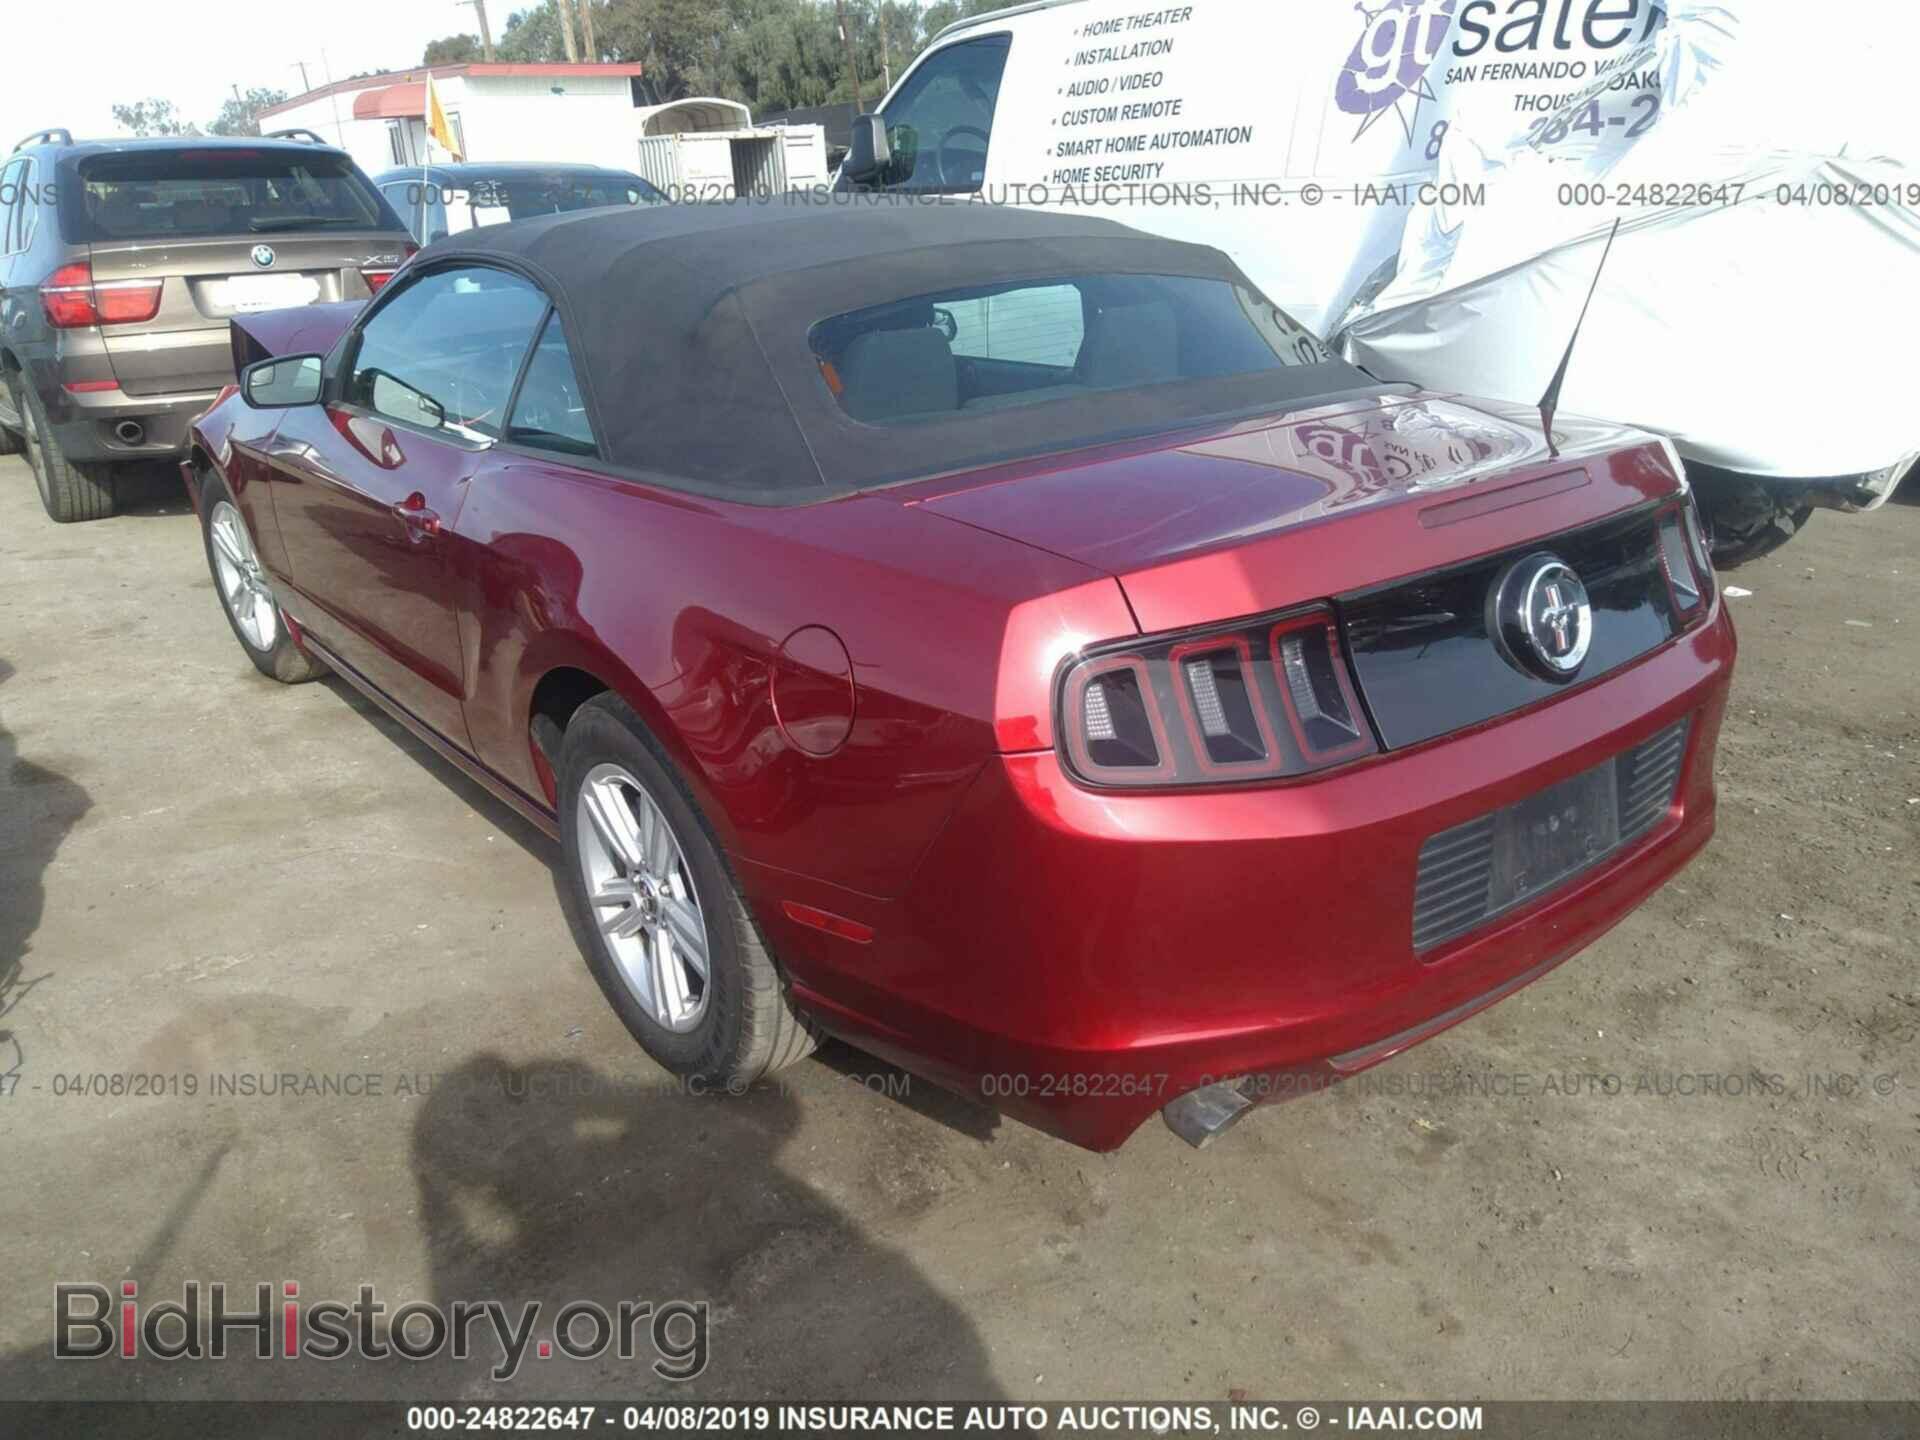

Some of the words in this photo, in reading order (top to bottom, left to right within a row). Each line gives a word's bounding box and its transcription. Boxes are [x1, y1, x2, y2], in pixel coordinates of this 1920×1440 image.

[1082, 17, 1125, 38] HOME
[1127, 6, 1193, 30] THEATER
[1074, 38, 1174, 66] INSTALLATION
[1066, 77, 1110, 98] AUDIO
[1119, 71, 1164, 91] VIDEO
[1444, 64, 1478, 85] SAN
[1481, 61, 1587, 81] FERNANDO
[1061, 106, 1118, 127] CUSTOM
[1121, 99, 1183, 121] REMOTE
[1056, 138, 1102, 158] SMART
[1104, 134, 1147, 155] HOME
[1150, 126, 1253, 151] AUTOMATION
[1052, 167, 1091, 185] HOME
[1094, 162, 1165, 183] SECURITY
